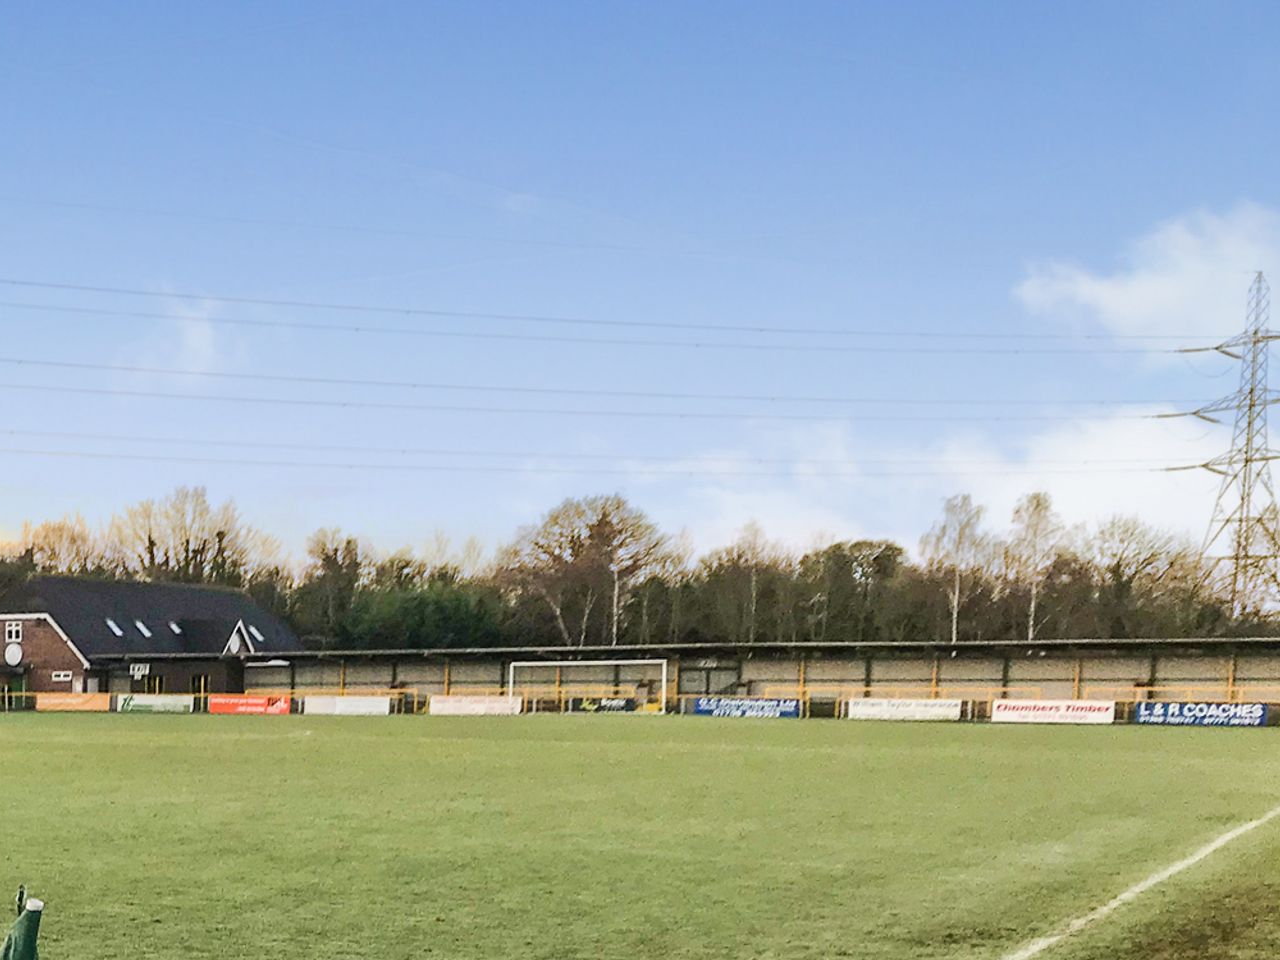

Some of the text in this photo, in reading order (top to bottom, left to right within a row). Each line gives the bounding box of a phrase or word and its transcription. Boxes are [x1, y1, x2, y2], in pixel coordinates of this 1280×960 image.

[996, 704, 1111, 713] Chambers Timber
[1140, 702, 1264, 718] L & R COACHES
